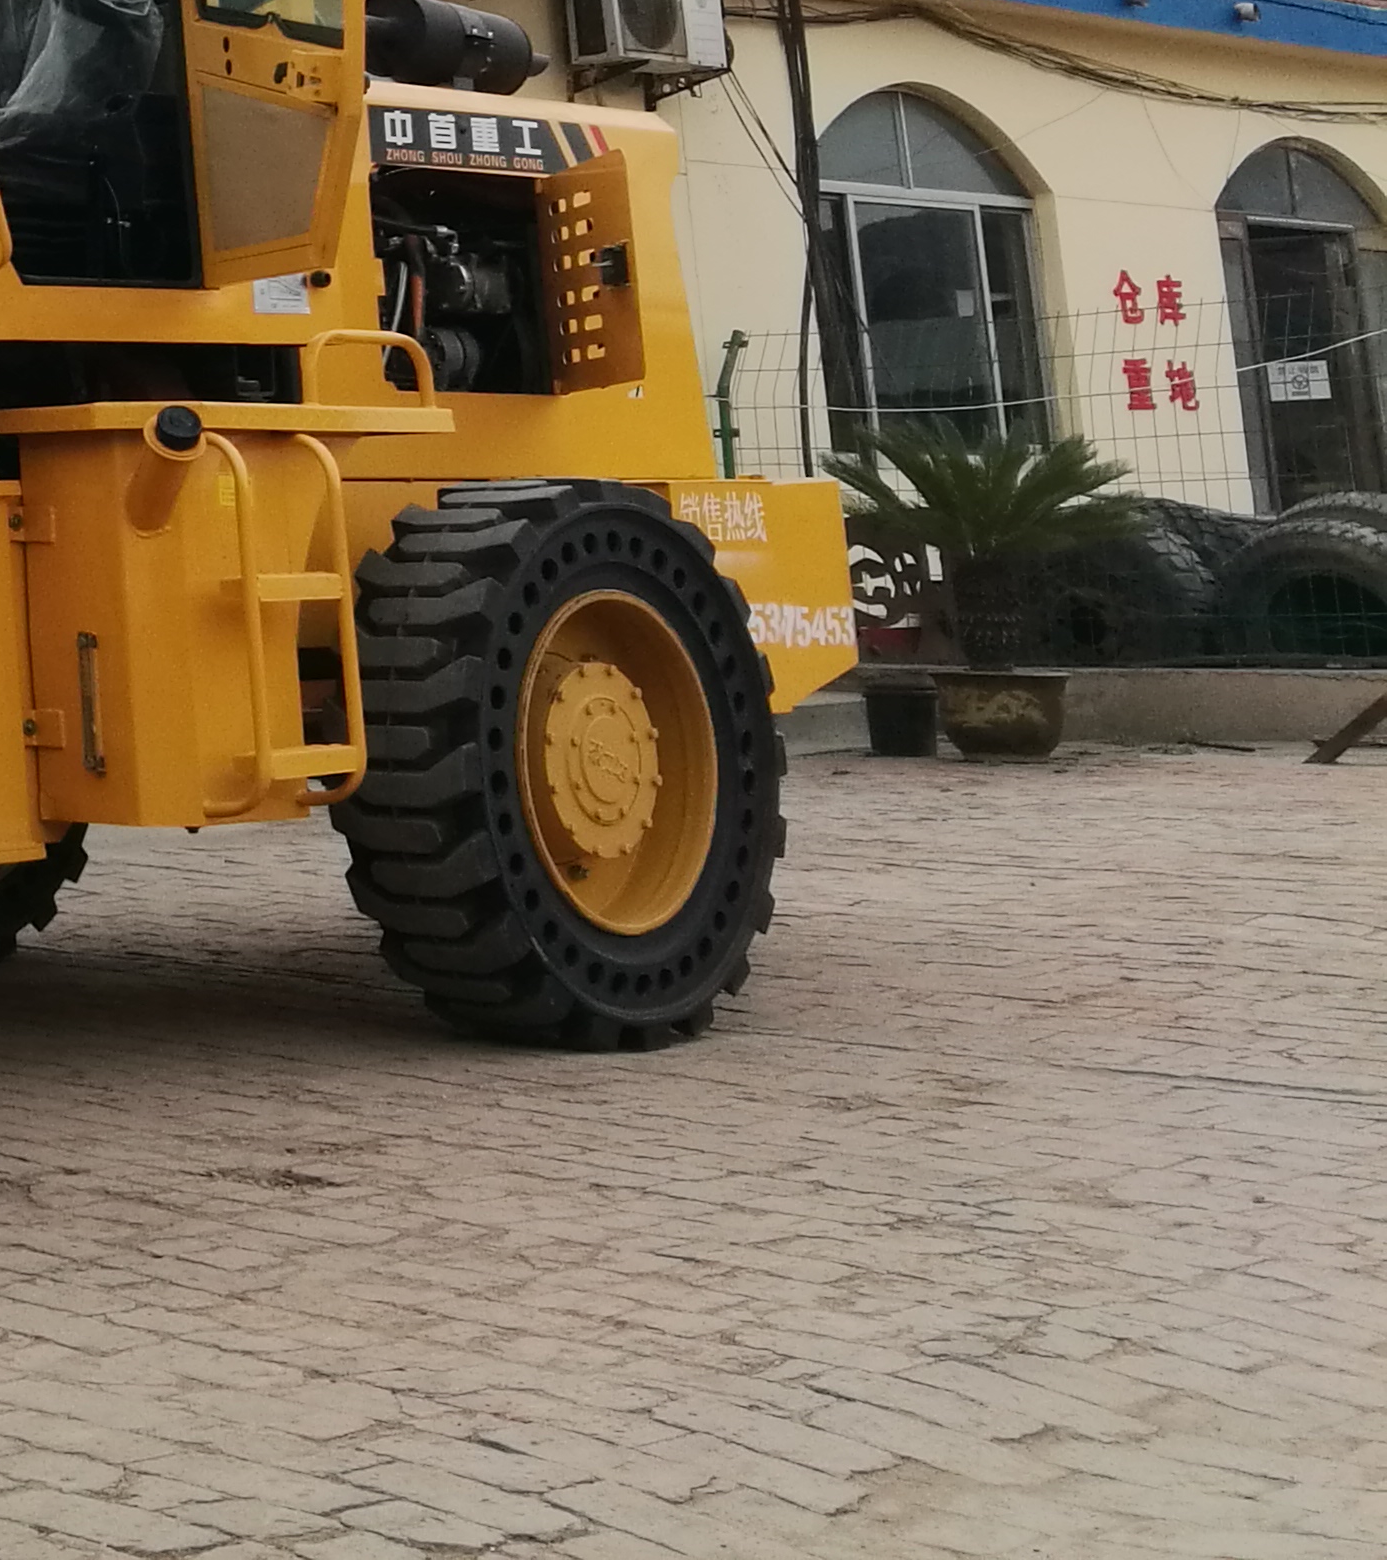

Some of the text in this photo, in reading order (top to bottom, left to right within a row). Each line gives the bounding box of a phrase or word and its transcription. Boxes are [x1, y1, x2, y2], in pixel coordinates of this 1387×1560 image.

[383, 110, 542, 156] 中首重工
[386, 148, 544, 171] ZHONG SHOU ZHONG GONG
[1113, 269, 1187, 327] 仓库
[1122, 358, 1200, 411] 重地
[680, 491, 768, 542] 销售热线
